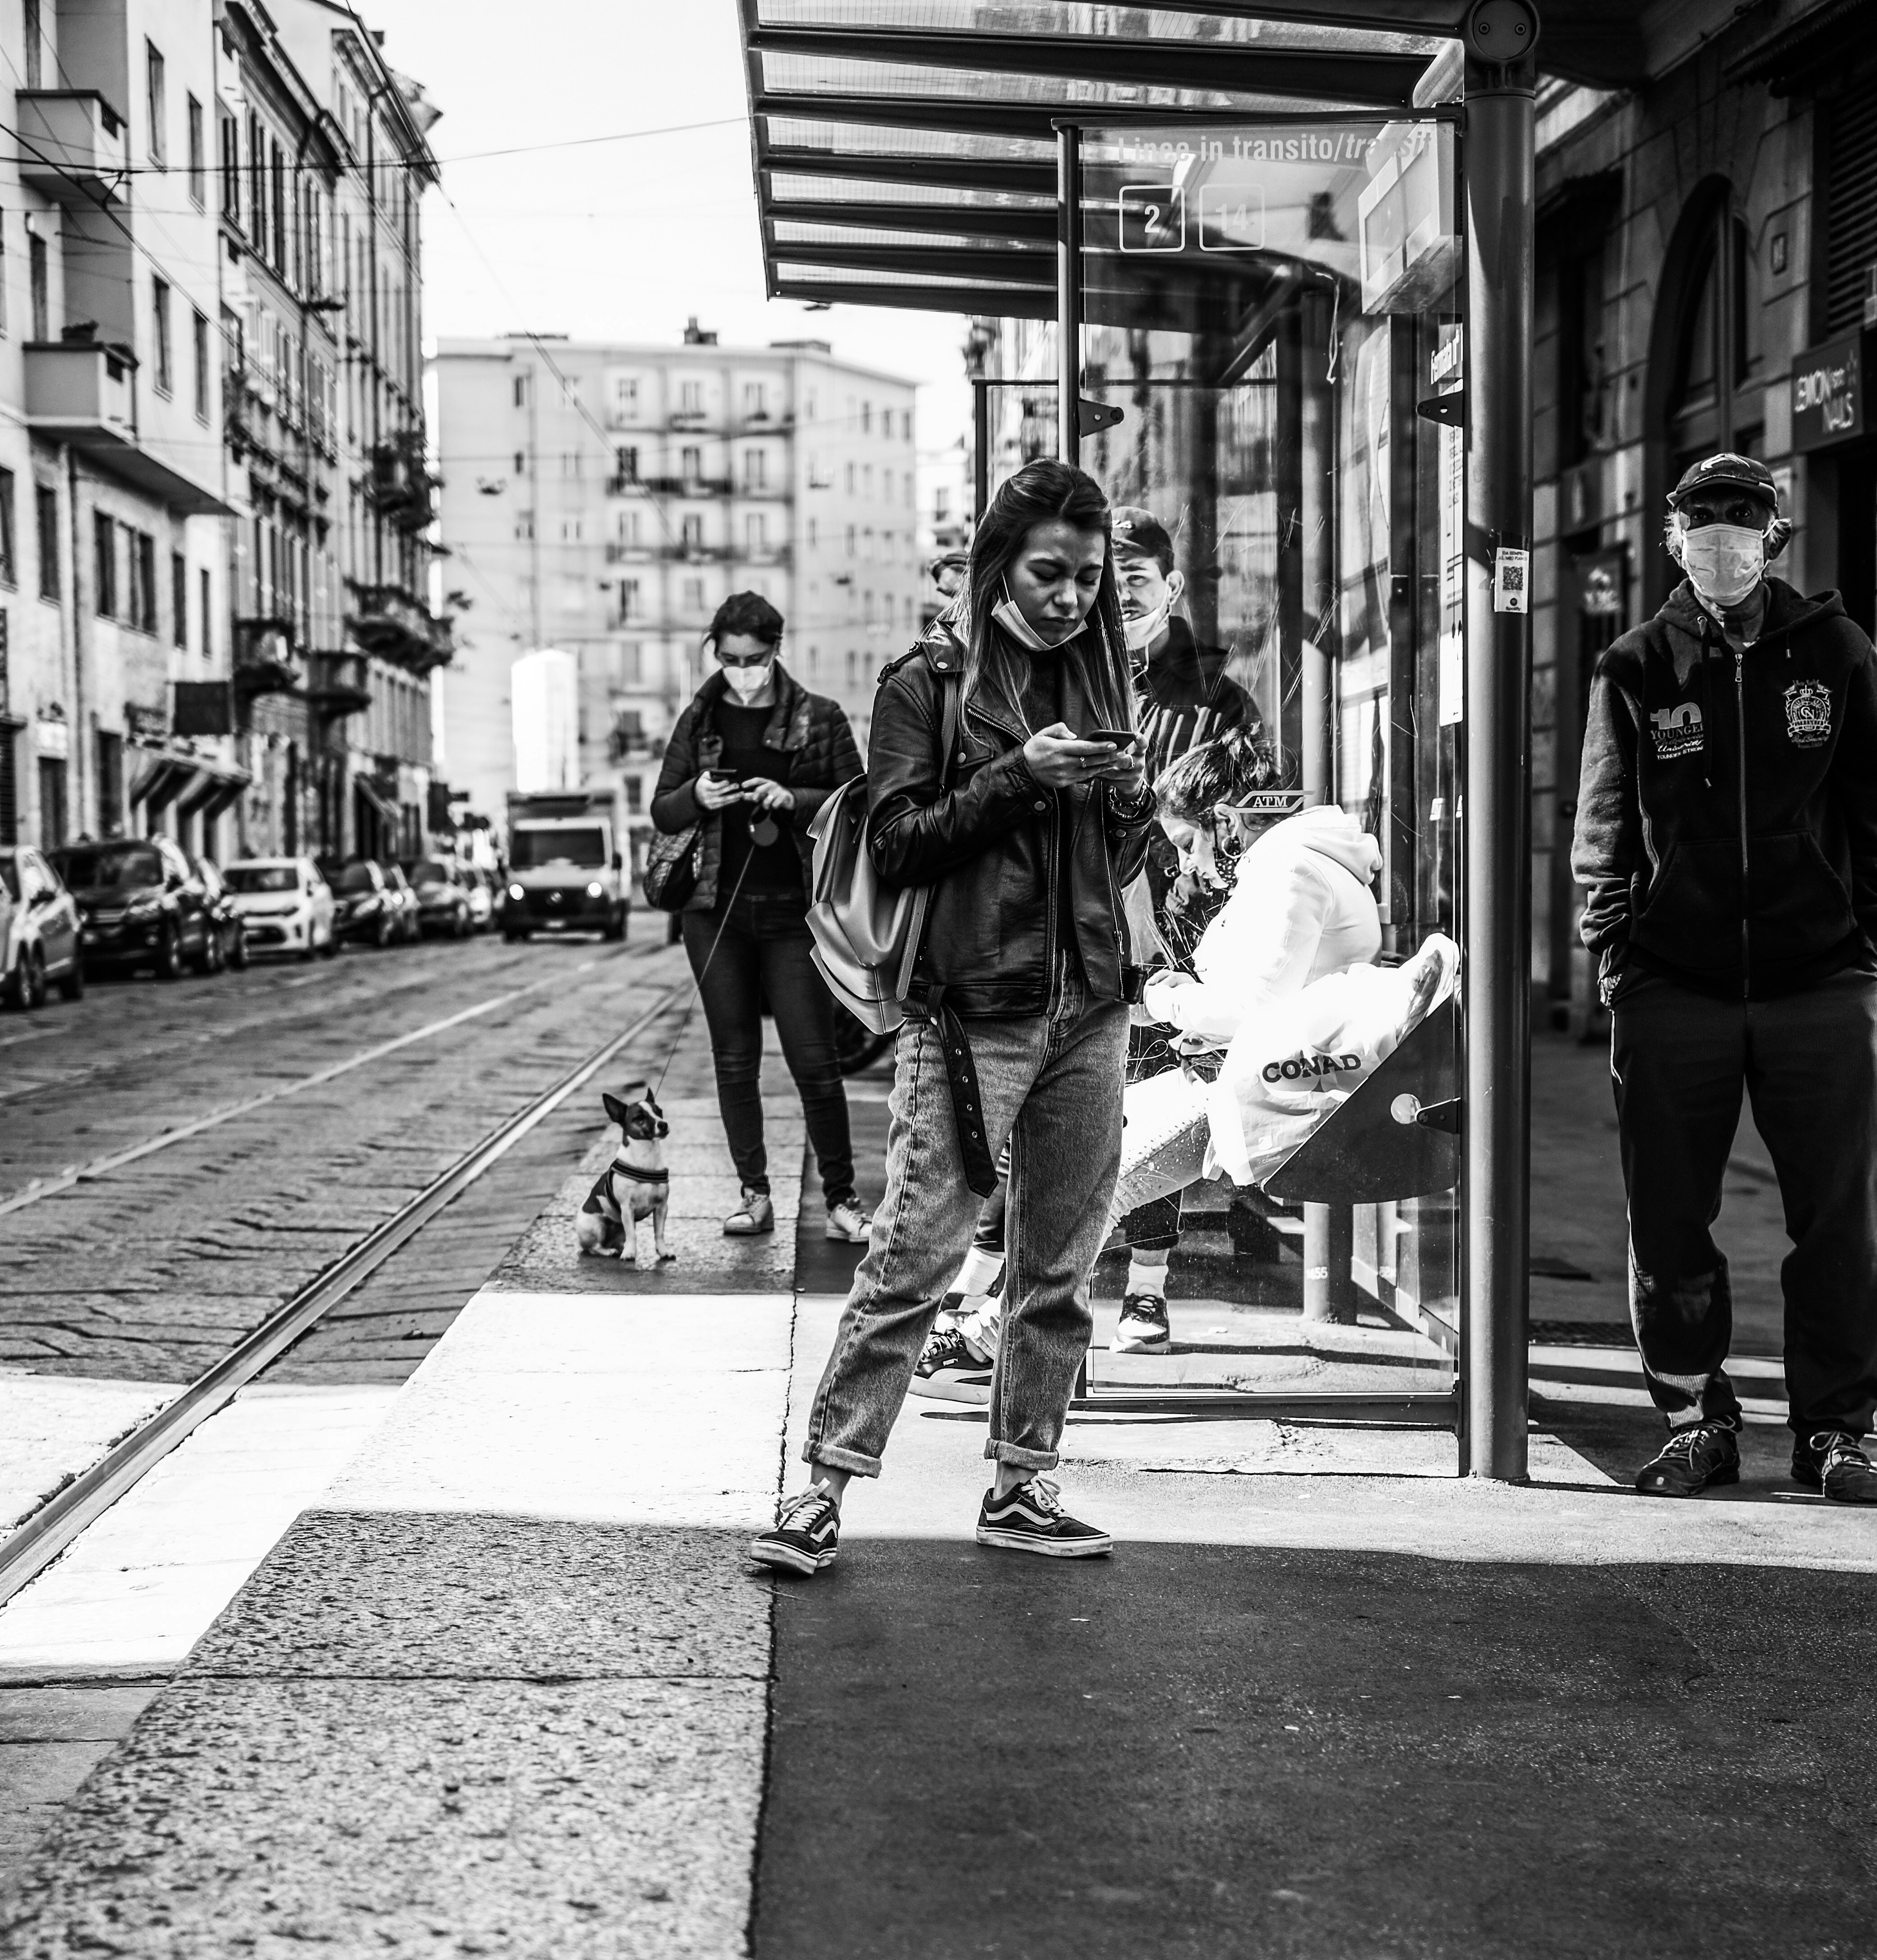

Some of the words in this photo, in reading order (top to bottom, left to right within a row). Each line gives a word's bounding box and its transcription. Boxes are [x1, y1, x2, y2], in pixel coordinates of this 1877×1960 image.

[1118, 137, 1189, 162] Linee
[1200, 135, 1223, 162] in
[1144, 205, 1160, 233] 2
[1215, 203, 1249, 231] 14
[1253, 796, 1288, 808] ATM
[1262, 1054, 1361, 1083] CONAD
